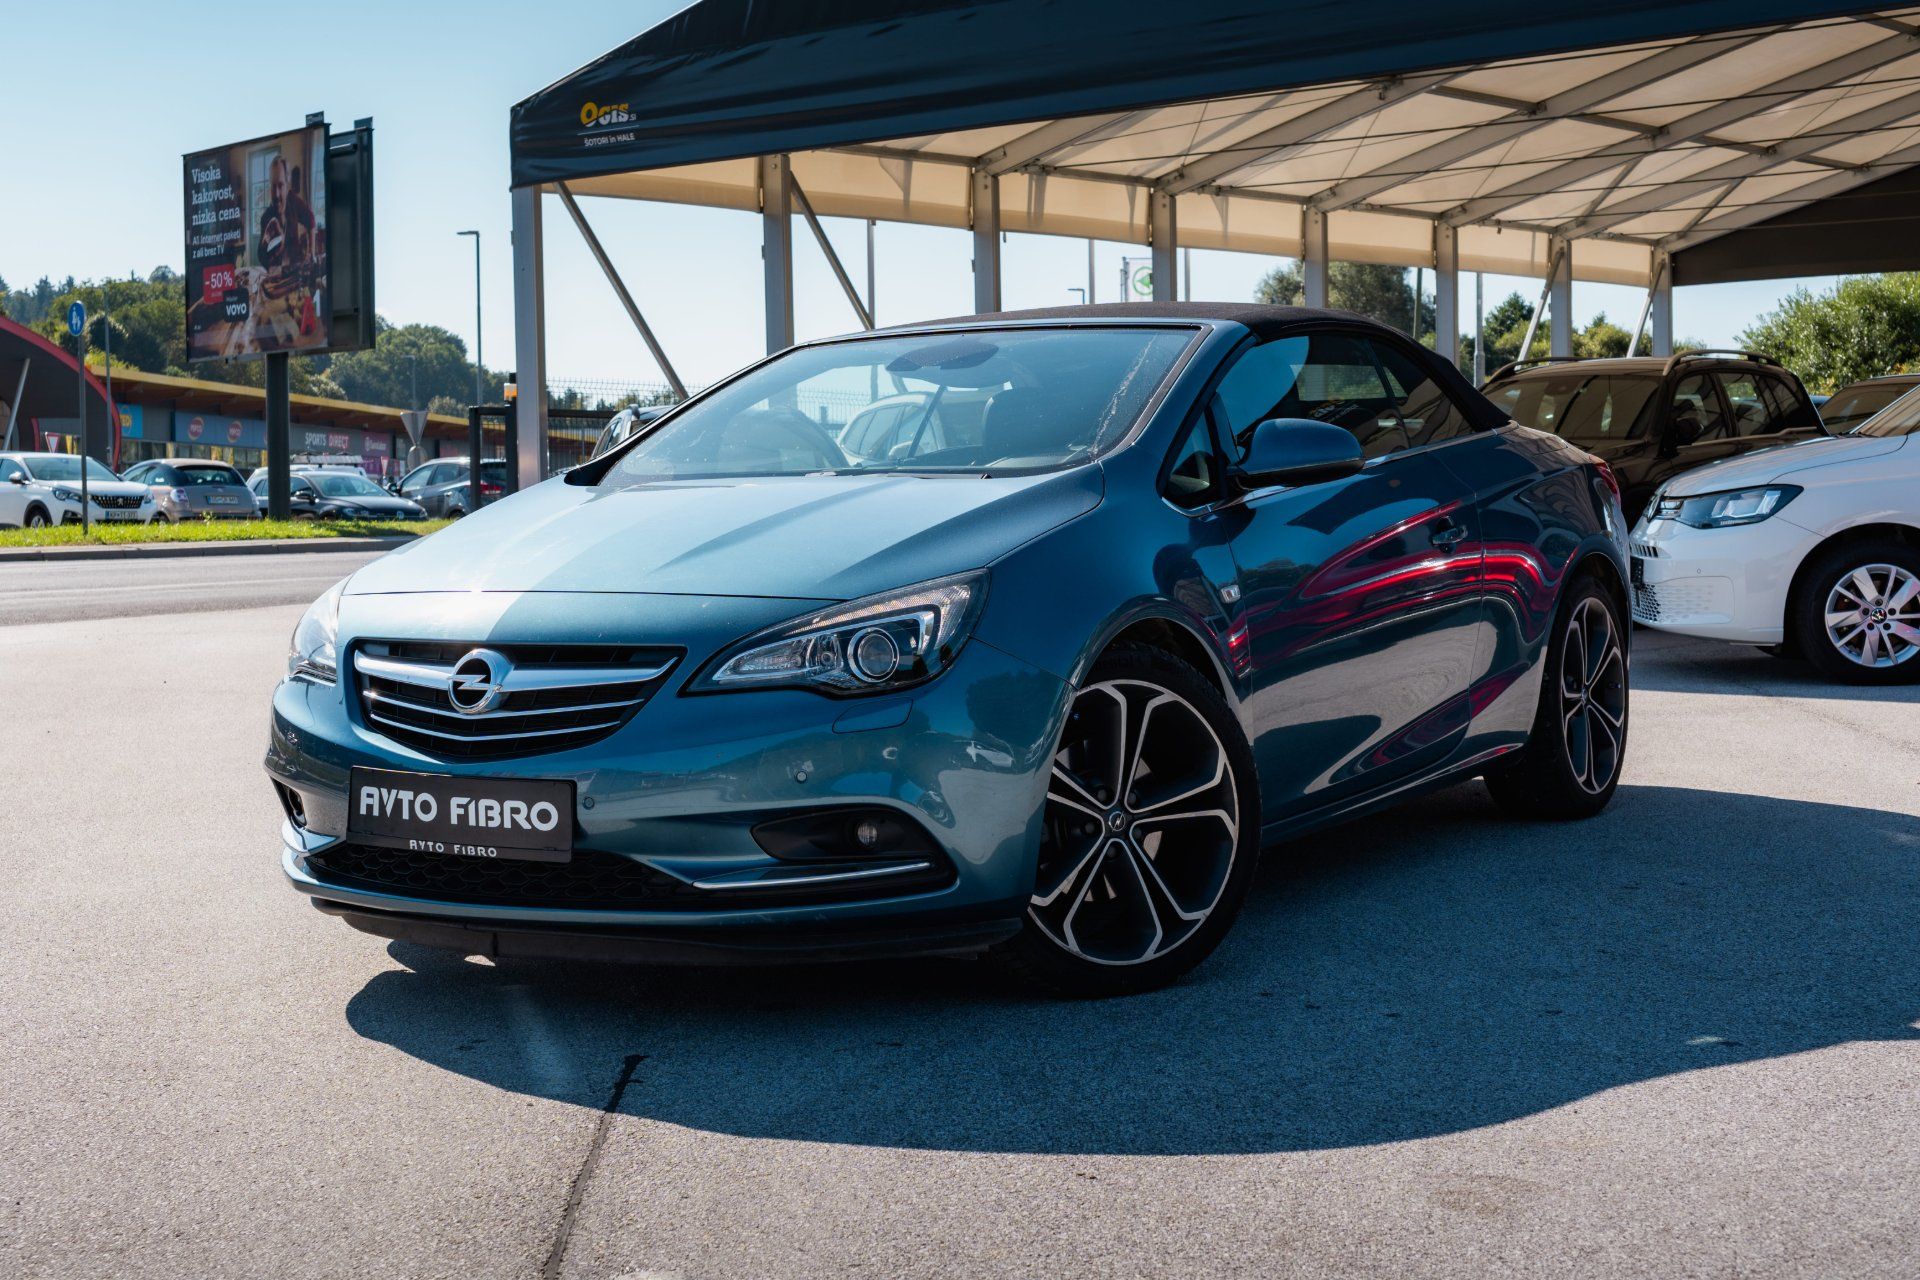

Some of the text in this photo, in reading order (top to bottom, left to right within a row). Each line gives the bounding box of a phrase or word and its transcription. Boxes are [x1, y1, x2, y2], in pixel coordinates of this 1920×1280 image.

[616, 132, 636, 142] HALE
[191, 165, 221, 184] Visoka
[192, 184, 235, 205] kakovost,
[192, 207, 241, 226] nizka cena
[217, 244, 225, 255] TV
[226, 303, 247, 316] VOYO
[305, 432, 349, 449] SPORTS DIRECT
[450, 797, 559, 831] FIBRO
[453, 845, 498, 858] FIBRO
